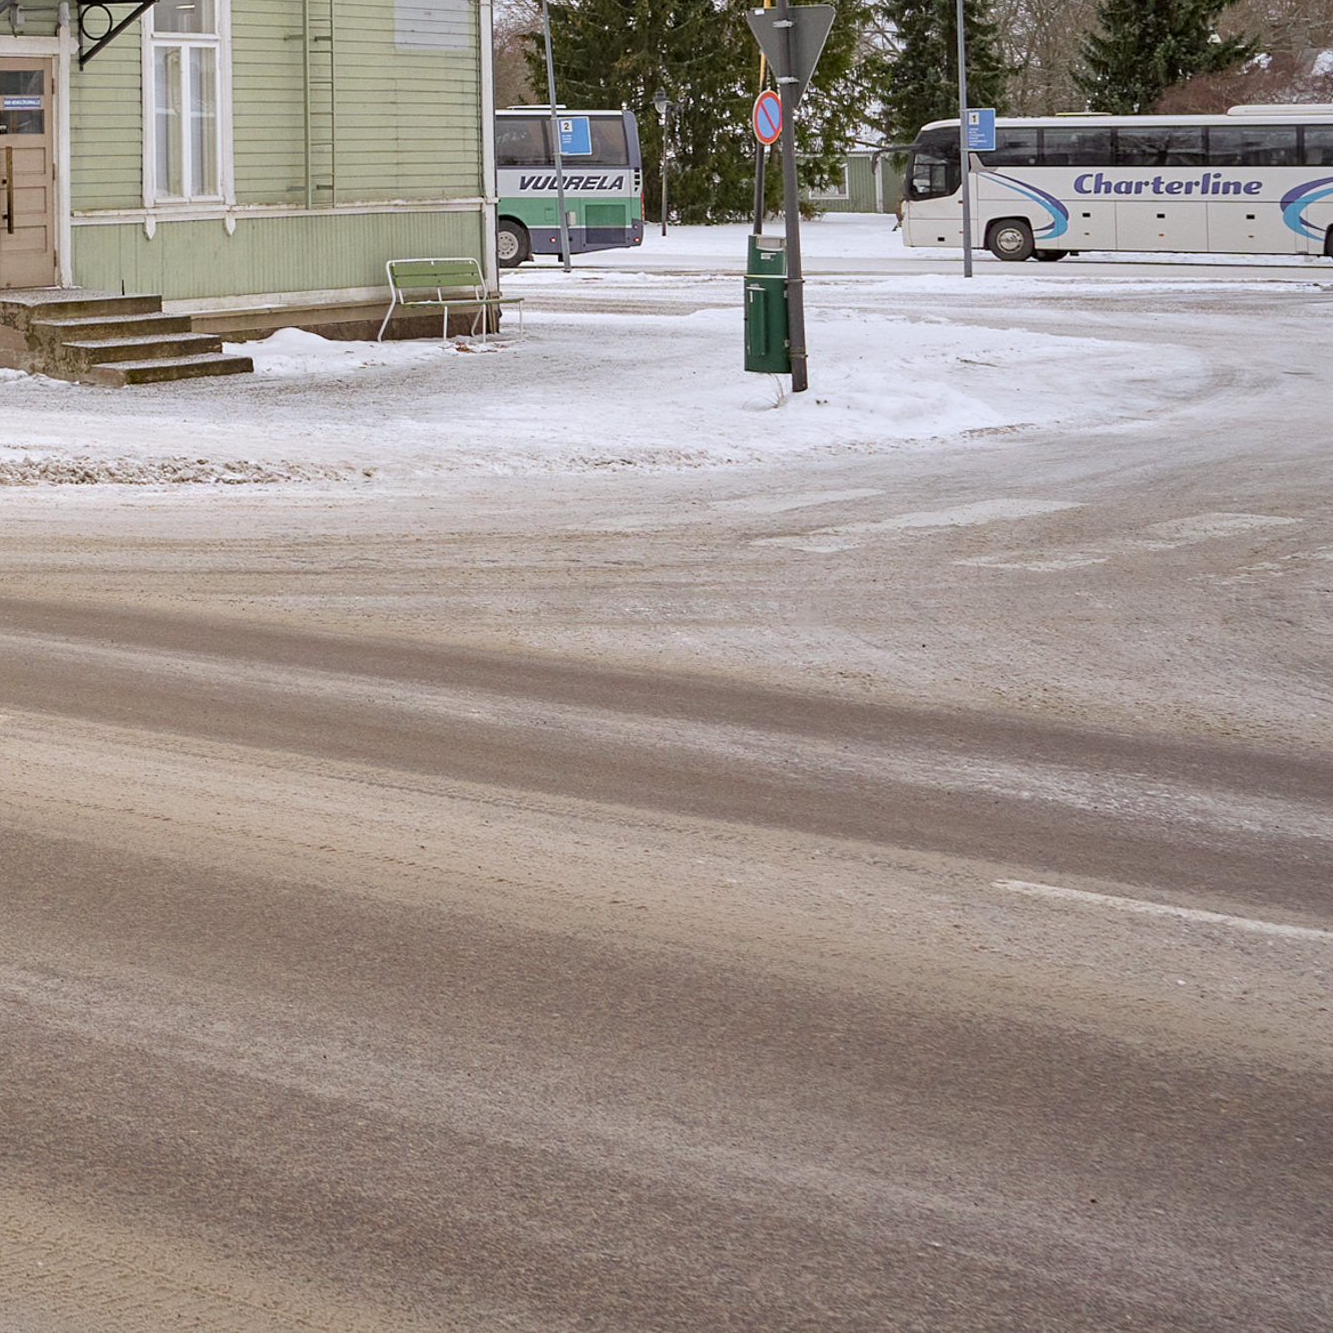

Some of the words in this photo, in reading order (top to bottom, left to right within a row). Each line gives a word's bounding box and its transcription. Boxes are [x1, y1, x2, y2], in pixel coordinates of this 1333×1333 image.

[563, 122, 569, 130] 2
[519, 175, 624, 190] VUORELA
[1074, 172, 1263, 195] Charterline
